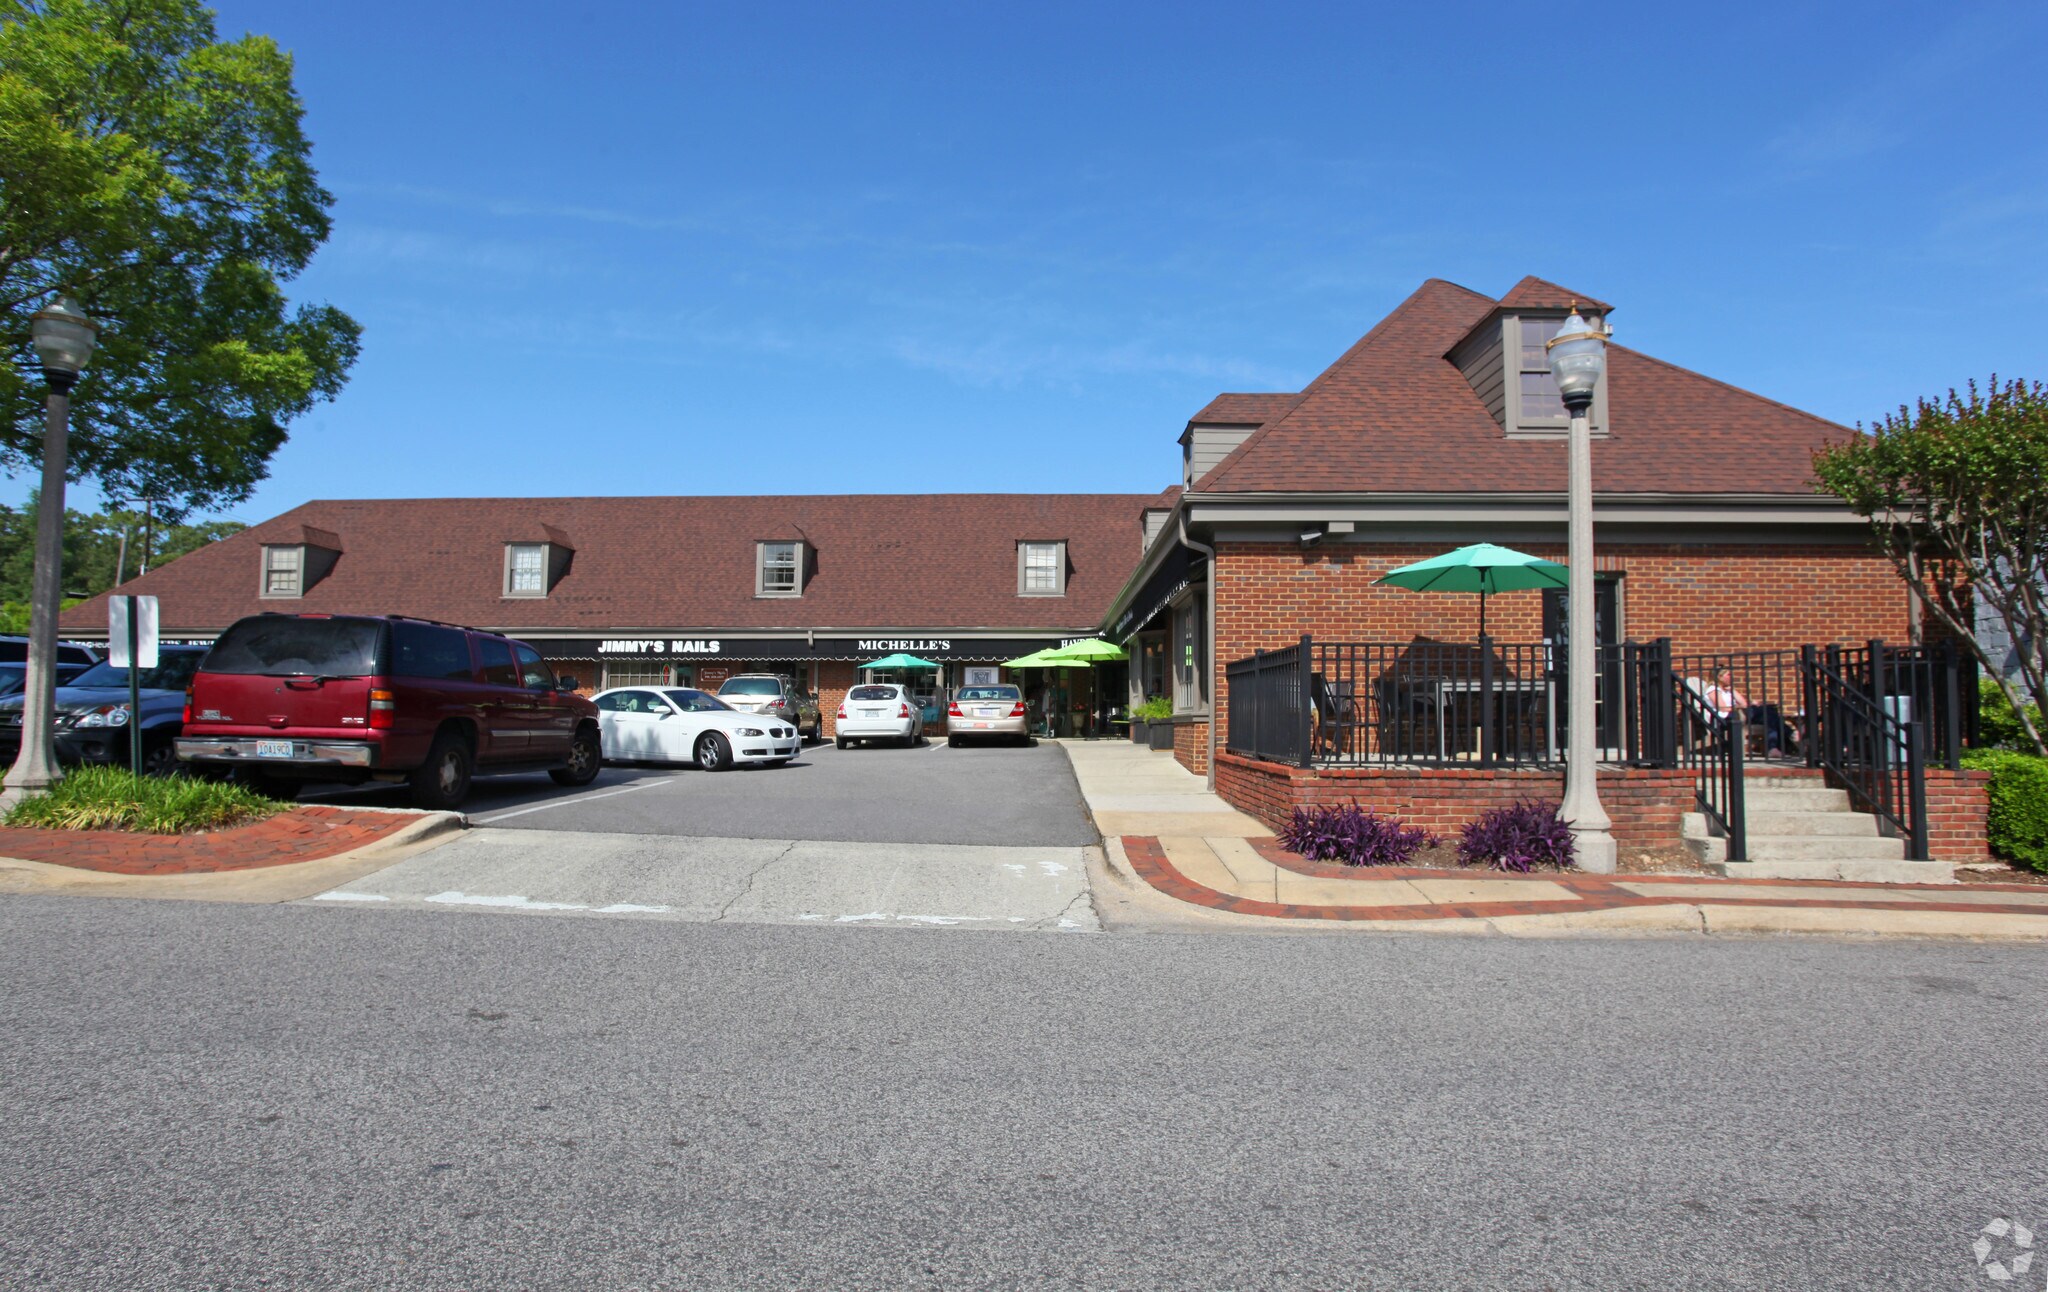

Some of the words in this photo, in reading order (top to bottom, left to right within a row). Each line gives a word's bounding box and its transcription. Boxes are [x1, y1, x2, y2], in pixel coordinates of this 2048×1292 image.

[597, 640, 665, 653] JIMMY'S
[671, 640, 720, 653] NAILS
[857, 640, 951, 651] MICHELLE'S
